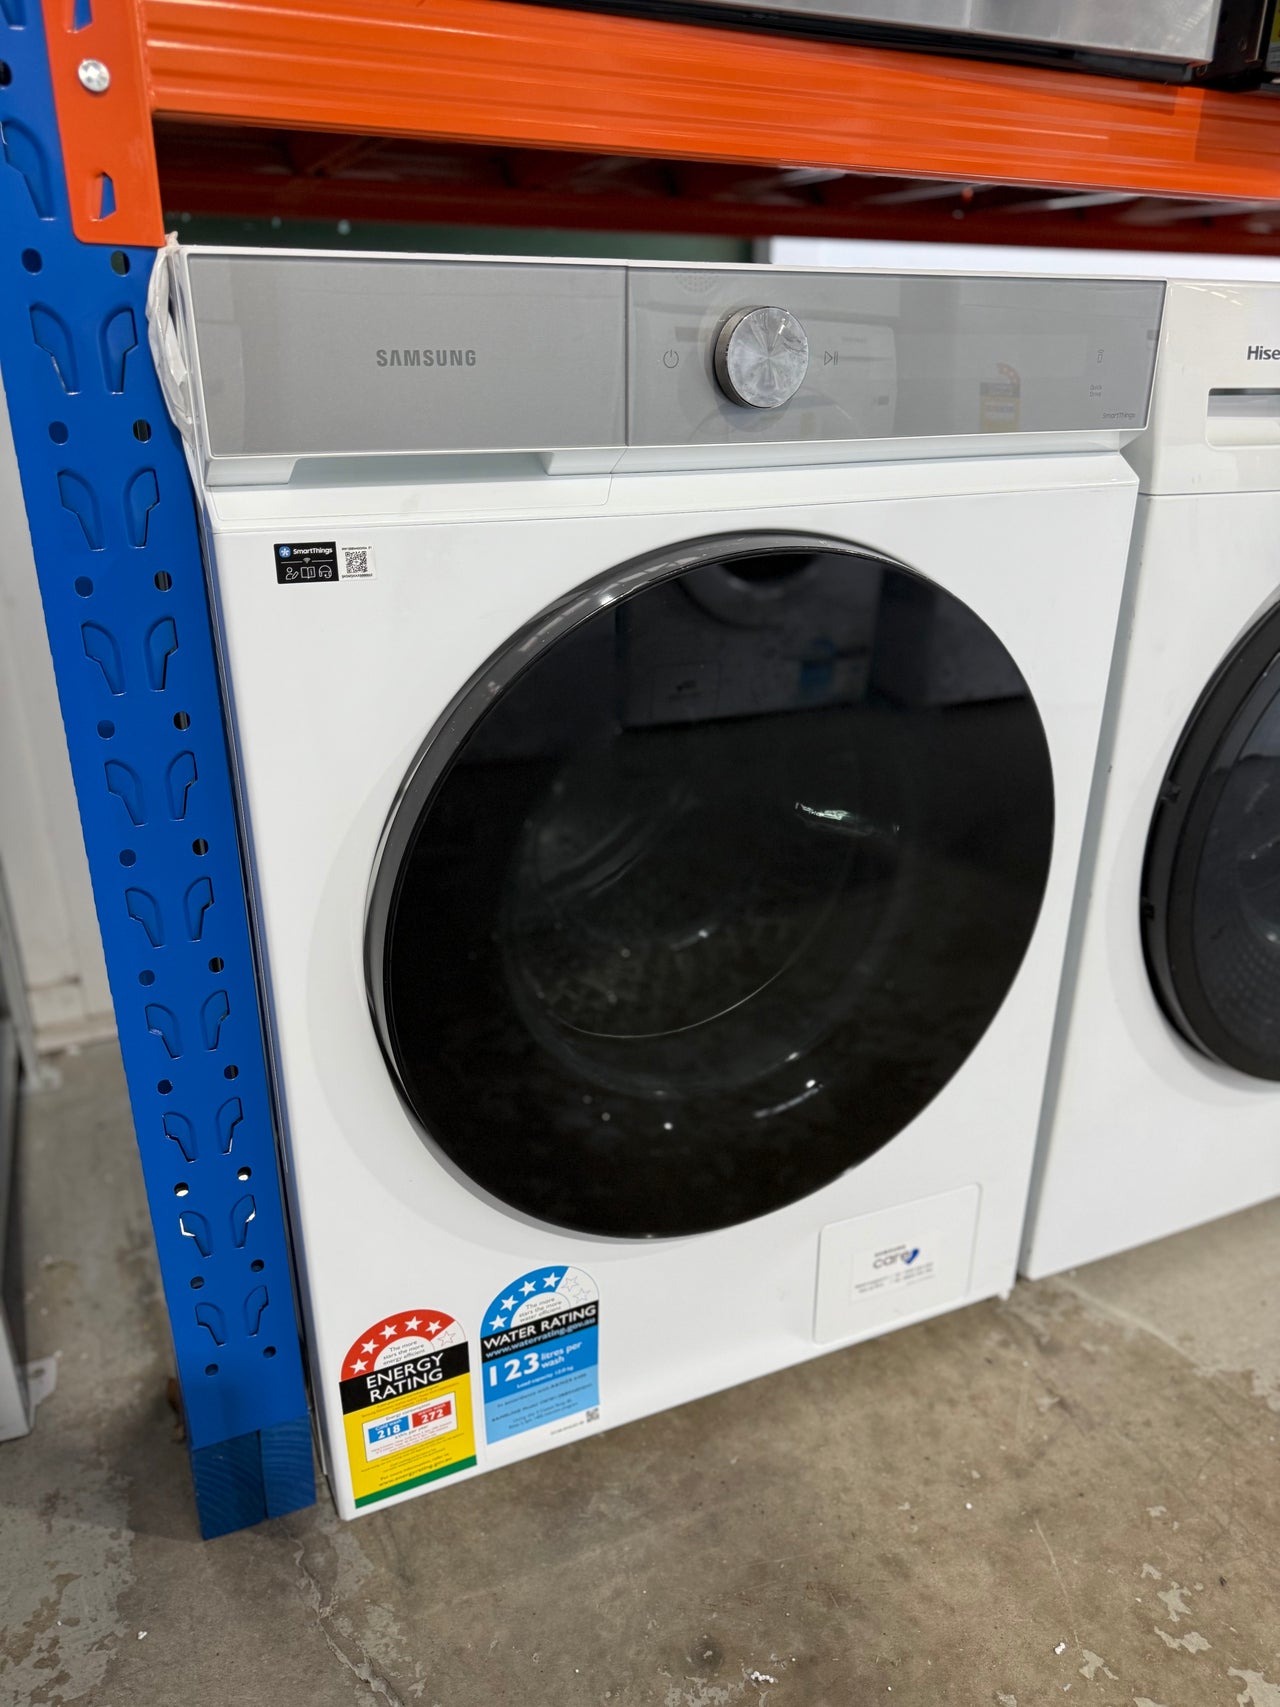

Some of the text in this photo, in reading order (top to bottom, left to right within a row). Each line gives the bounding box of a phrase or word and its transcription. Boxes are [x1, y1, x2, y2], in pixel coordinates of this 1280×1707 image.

[376, 349, 477, 367] SAMSUNG
[293, 547, 333, 555] SmartThings
[534, 1305, 545, 1313] the
[545, 1300, 563, 1310] more
[538, 1297, 555, 1306] more
[519, 1314, 537, 1323] water
[483, 1304, 597, 1350] WATER RATING
[402, 1340, 417, 1349] more
[485, 1317, 596, 1359] www.waterrating.gov.au
[409, 1344, 425, 1352] more
[541, 1341, 583, 1361] litres per
[383, 1349, 426, 1366] energy efficient
[541, 1355, 565, 1369] wash
[366, 1352, 444, 1389] ENERGY
[489, 1352, 540, 1388] 123
[369, 1368, 443, 1403] RATING
[421, 1408, 444, 1424] 272
[377, 1424, 401, 1440] 218
